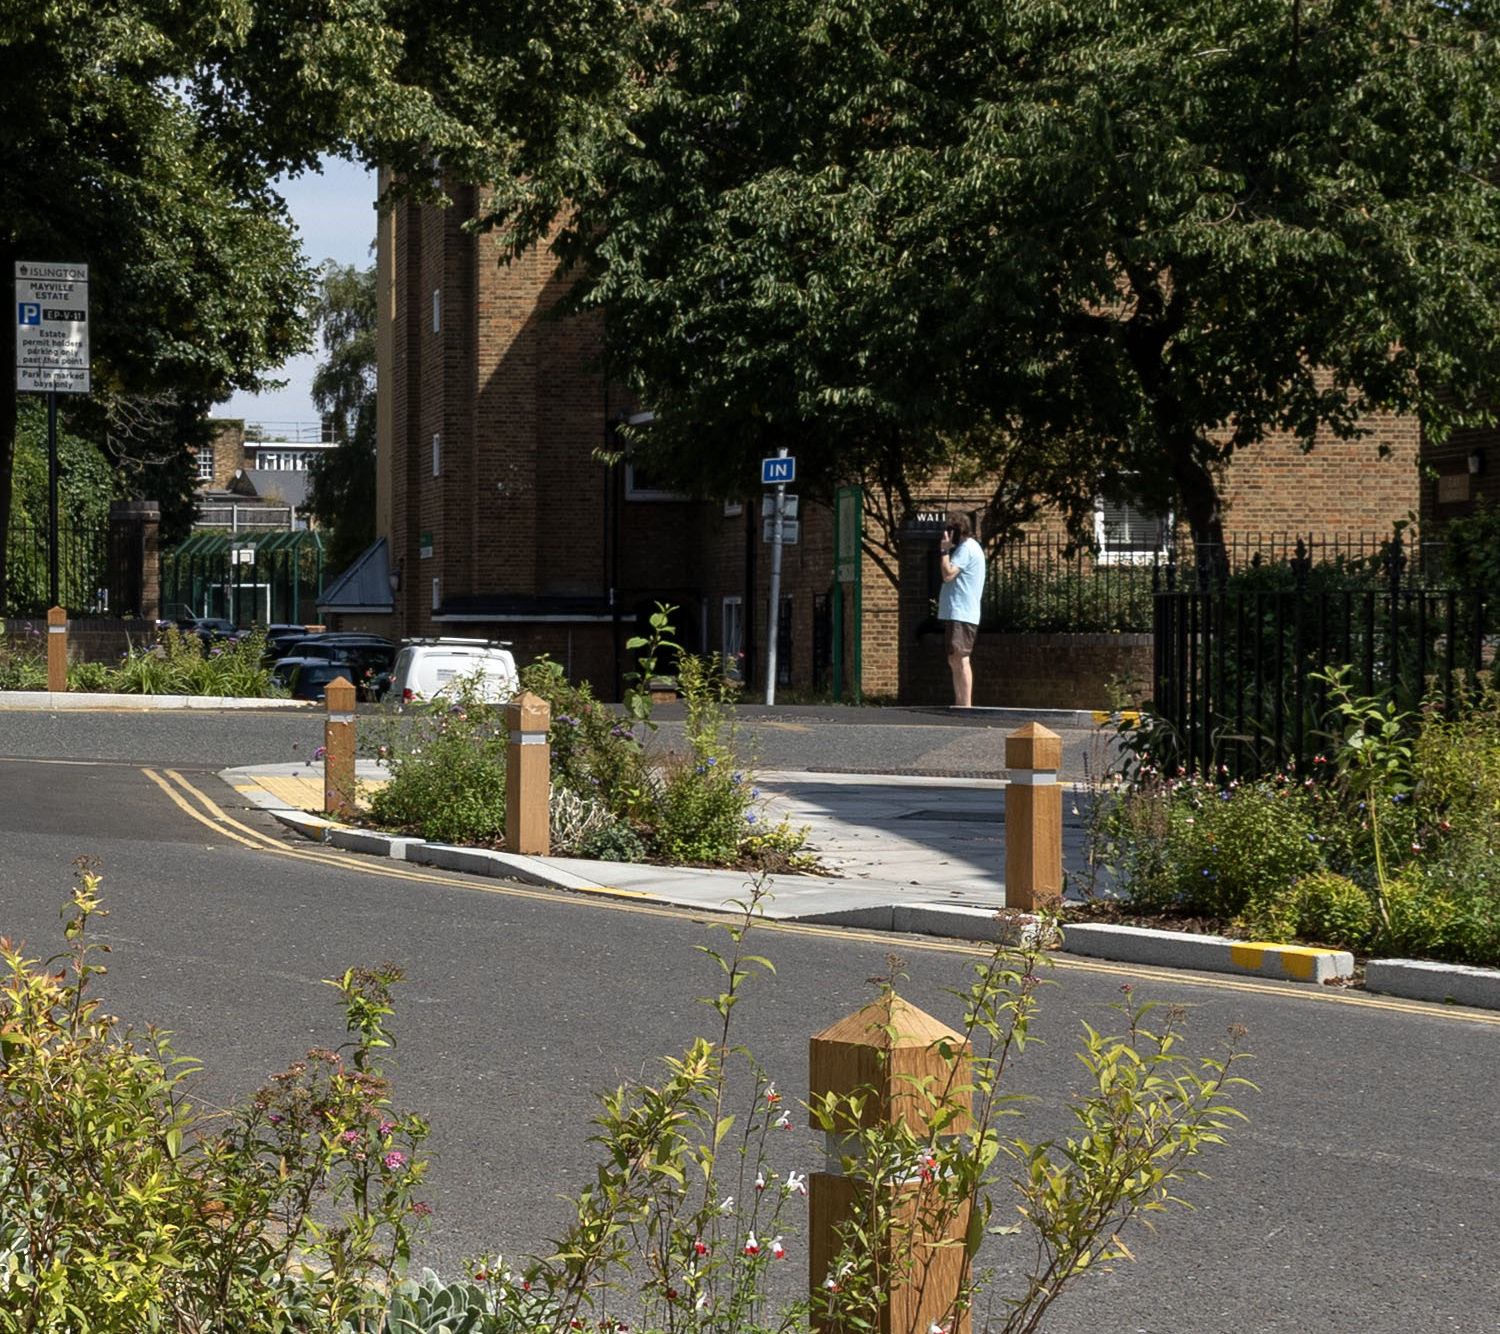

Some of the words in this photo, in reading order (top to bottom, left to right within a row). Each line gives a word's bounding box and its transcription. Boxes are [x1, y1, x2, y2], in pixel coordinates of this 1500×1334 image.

[30, 269, 85, 278] ISLINGTON
[30, 282, 74, 292] MAYVILLE
[35, 292, 69, 300] ESTATE
[23, 305, 37, 323] P
[39, 329, 66, 338] Estate
[22, 339, 49, 348] permit
[52, 339, 83, 347] holders
[27, 348, 58, 357] parking
[61, 348, 79, 357] only
[22, 357, 40, 365] past
[62, 357, 83, 365] point
[22, 370, 40, 378] Park
[53, 371, 84, 379] marked
[33, 380, 53, 389] bays
[54, 380, 73, 389] only
[769, 464, 787, 477] IN
